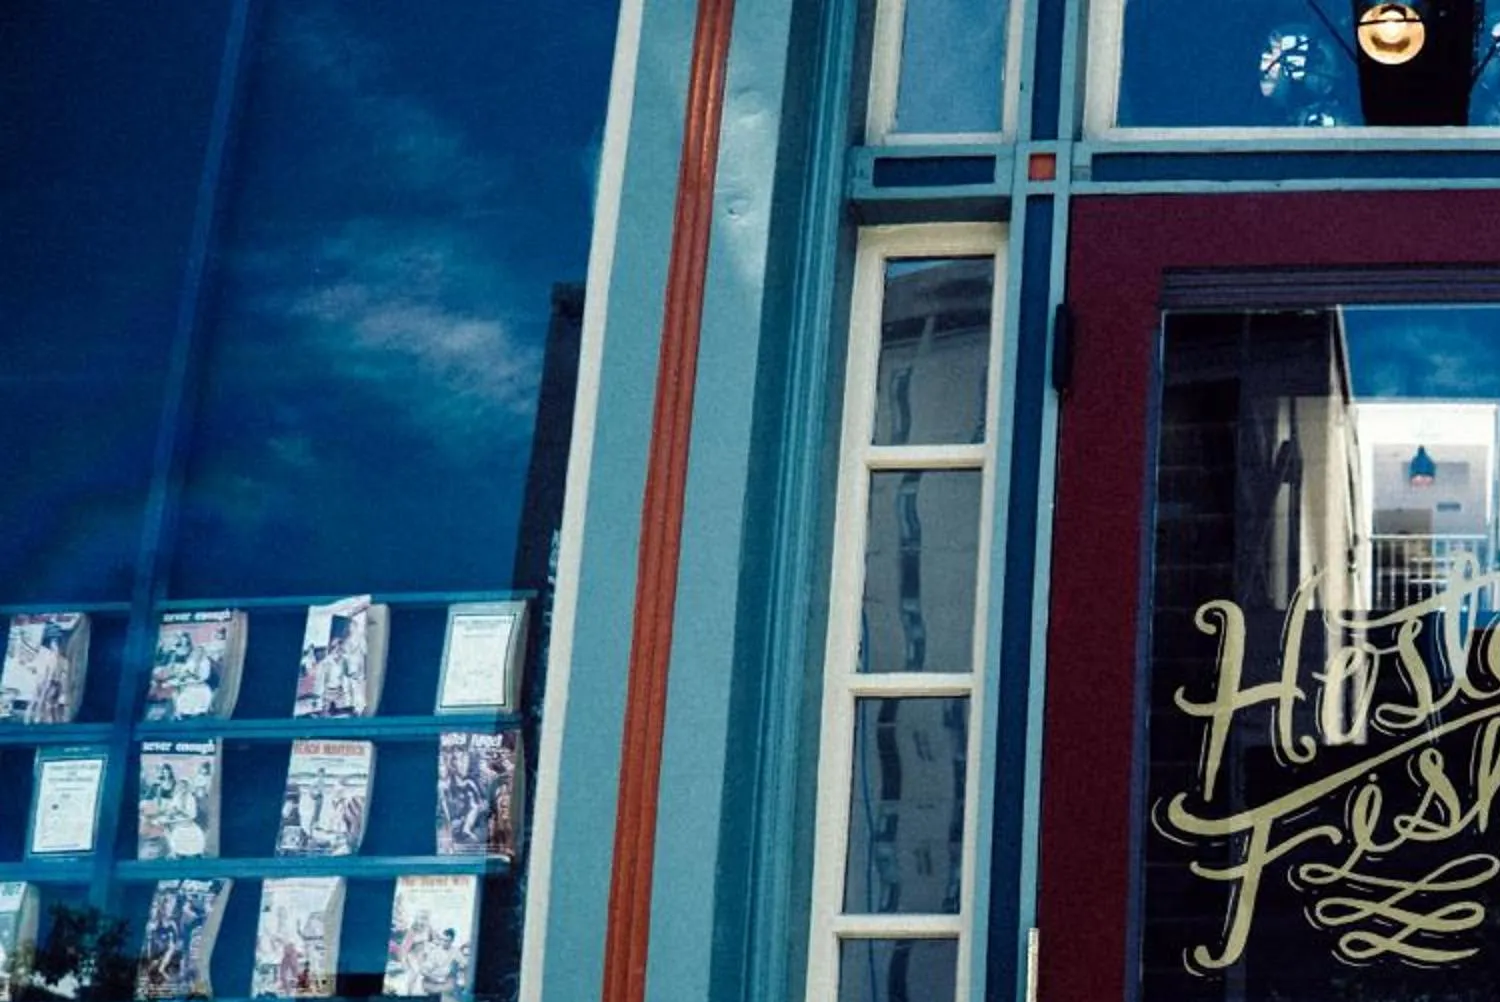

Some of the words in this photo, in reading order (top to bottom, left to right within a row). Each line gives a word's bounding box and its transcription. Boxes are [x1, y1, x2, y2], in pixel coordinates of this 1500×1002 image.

[163, 612, 191, 622] never
[194, 609, 231, 622] enough
[142, 741, 172, 753] never
[176, 739, 216, 754] enough
